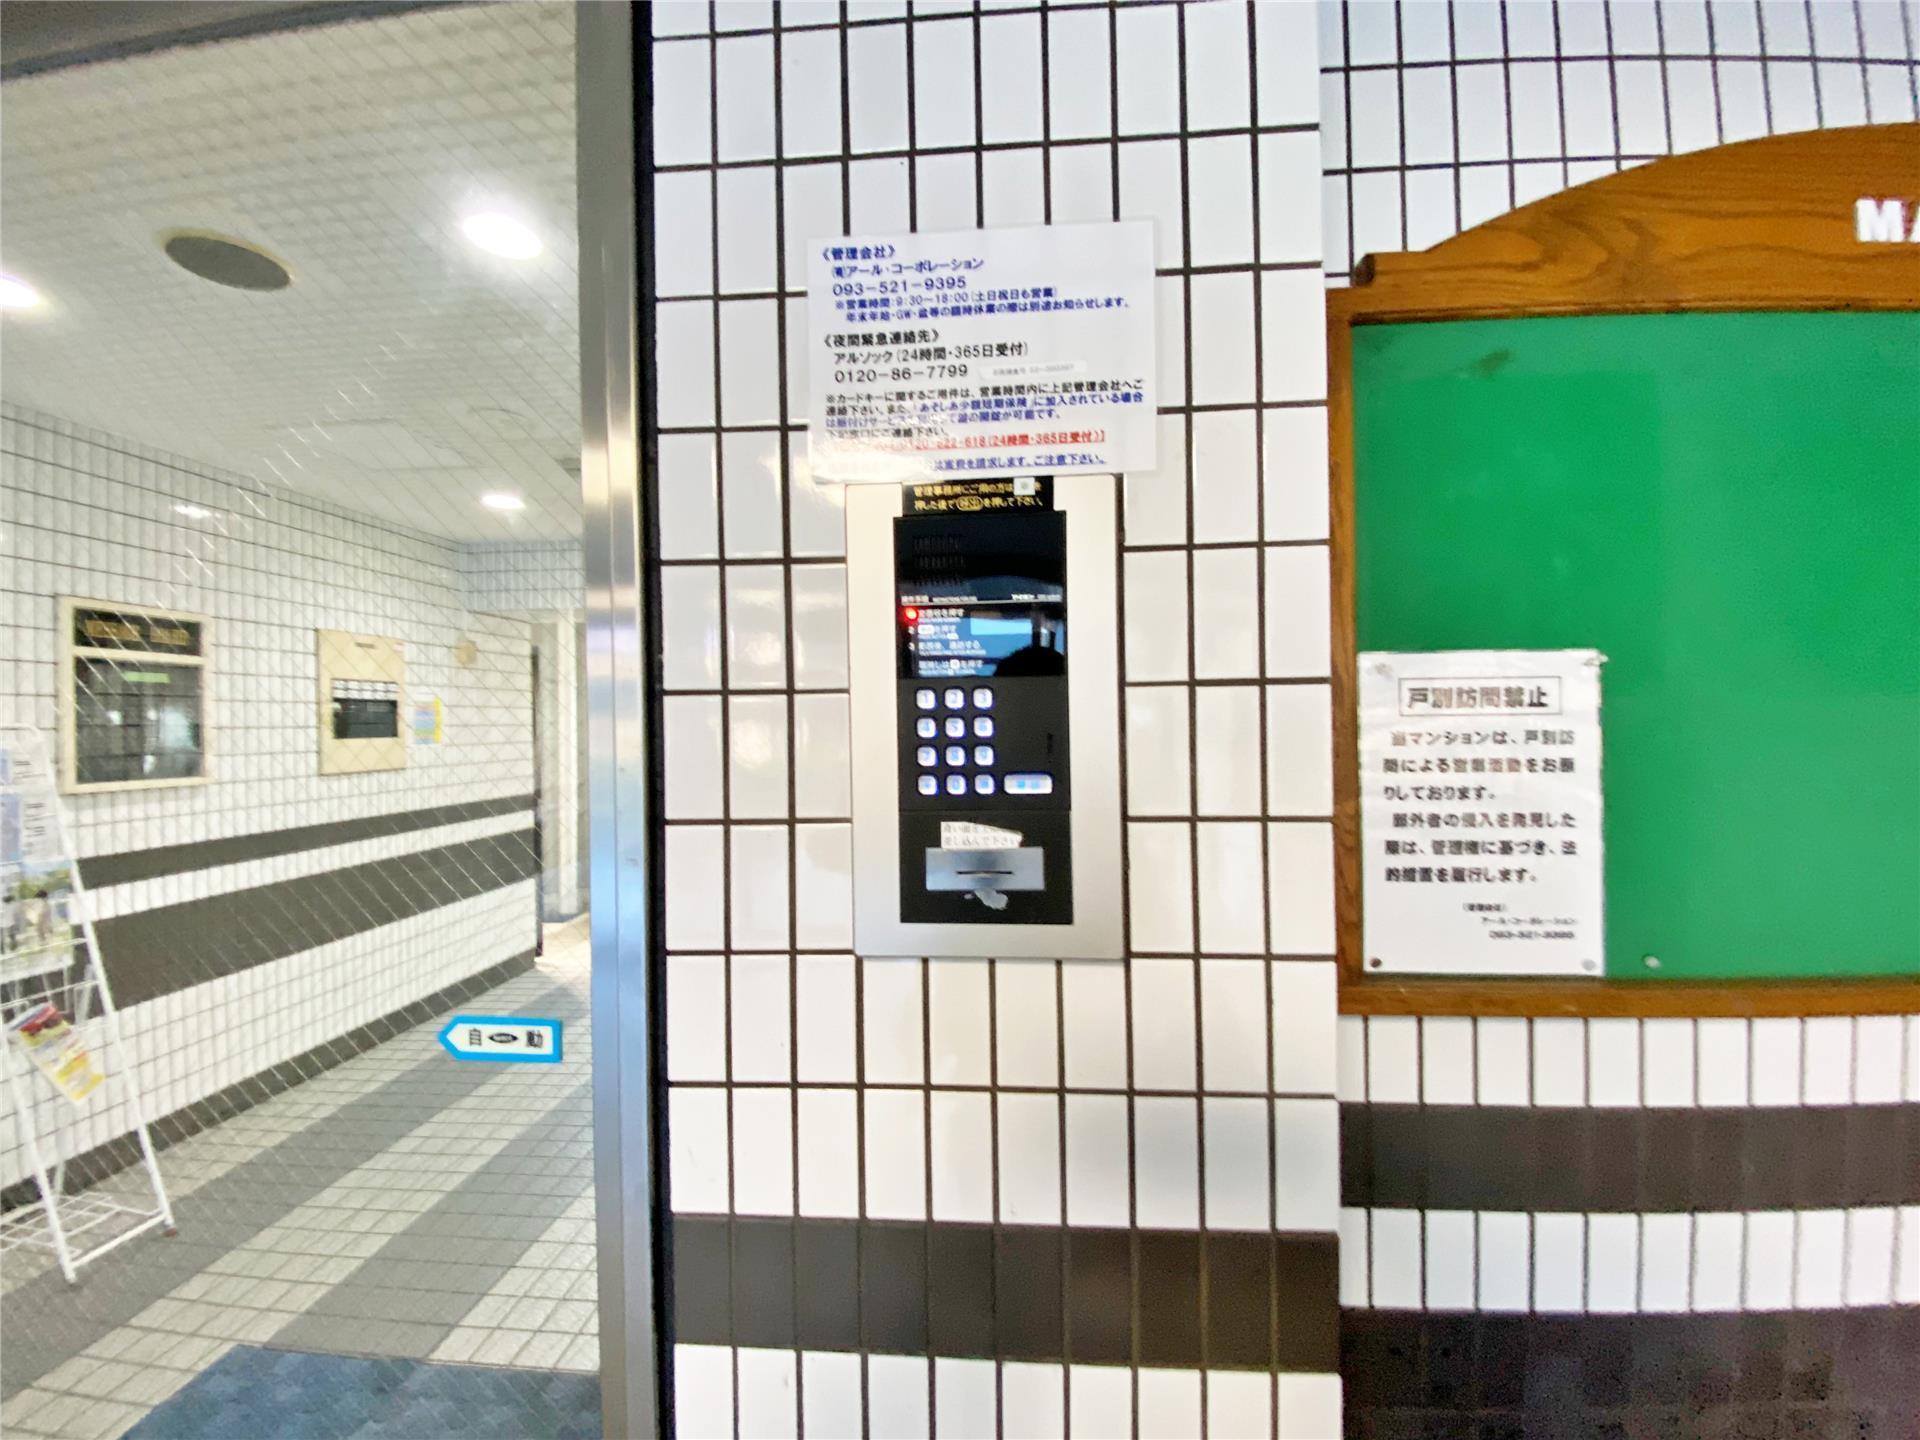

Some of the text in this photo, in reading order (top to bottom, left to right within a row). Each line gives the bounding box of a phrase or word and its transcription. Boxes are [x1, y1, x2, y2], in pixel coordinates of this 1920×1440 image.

[1856, 198, 1920, 243] M
[822, 245, 895, 261] 《管理会社》
[833, 276, 966, 297] 093-521-9395
[824, 329, 939, 348] 《夜間緊急連絡先》
[835, 364, 968, 384] 0120-86-7799
[1407, 685, 1549, 709] 戸別訪問禁止
[1391, 728, 1575, 746] 当マンションは、戸別訪
[1383, 756, 1575, 773] 問による営業活動をお願
[1384, 785, 1497, 801] りしております。
[1392, 812, 1577, 828] 部外者の侵入を発見した
